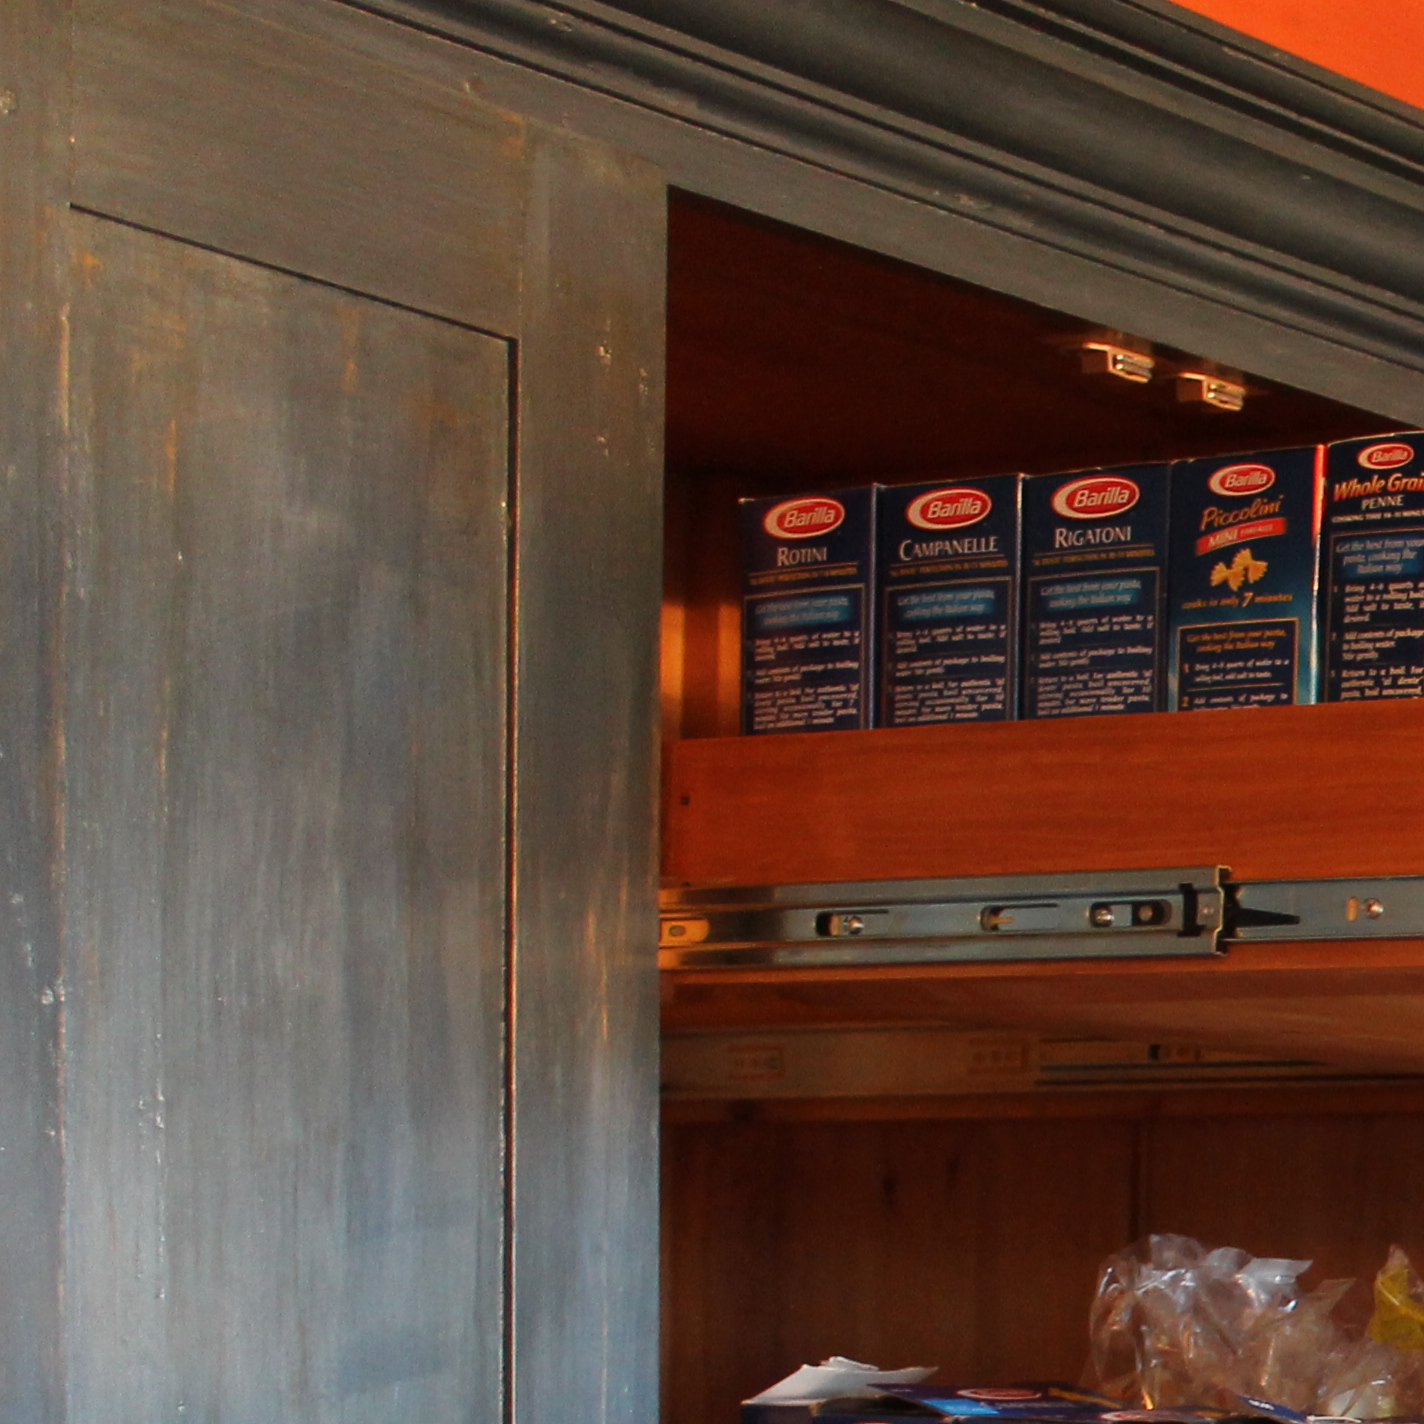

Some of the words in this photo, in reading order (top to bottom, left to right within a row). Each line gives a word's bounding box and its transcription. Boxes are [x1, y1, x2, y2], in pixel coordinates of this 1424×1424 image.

[1372, 450, 1408, 463] Barilla
[1225, 472, 1267, 488] Barilla
[1333, 476, 1384, 501] Whole
[1074, 486, 1129, 508] Barilla
[1361, 495, 1404, 510] PENNE
[784, 506, 835, 528] Barilla
[927, 499, 982, 519] Barilla
[1200, 495, 1284, 531] Piccolini
[1055, 526, 1131, 548] RIGATONI
[1208, 531, 1238, 547] MINI
[777, 547, 827, 566] ROTINI
[899, 536, 998, 561] CAMPANELLE
[1242, 592, 1254, 607] 7
